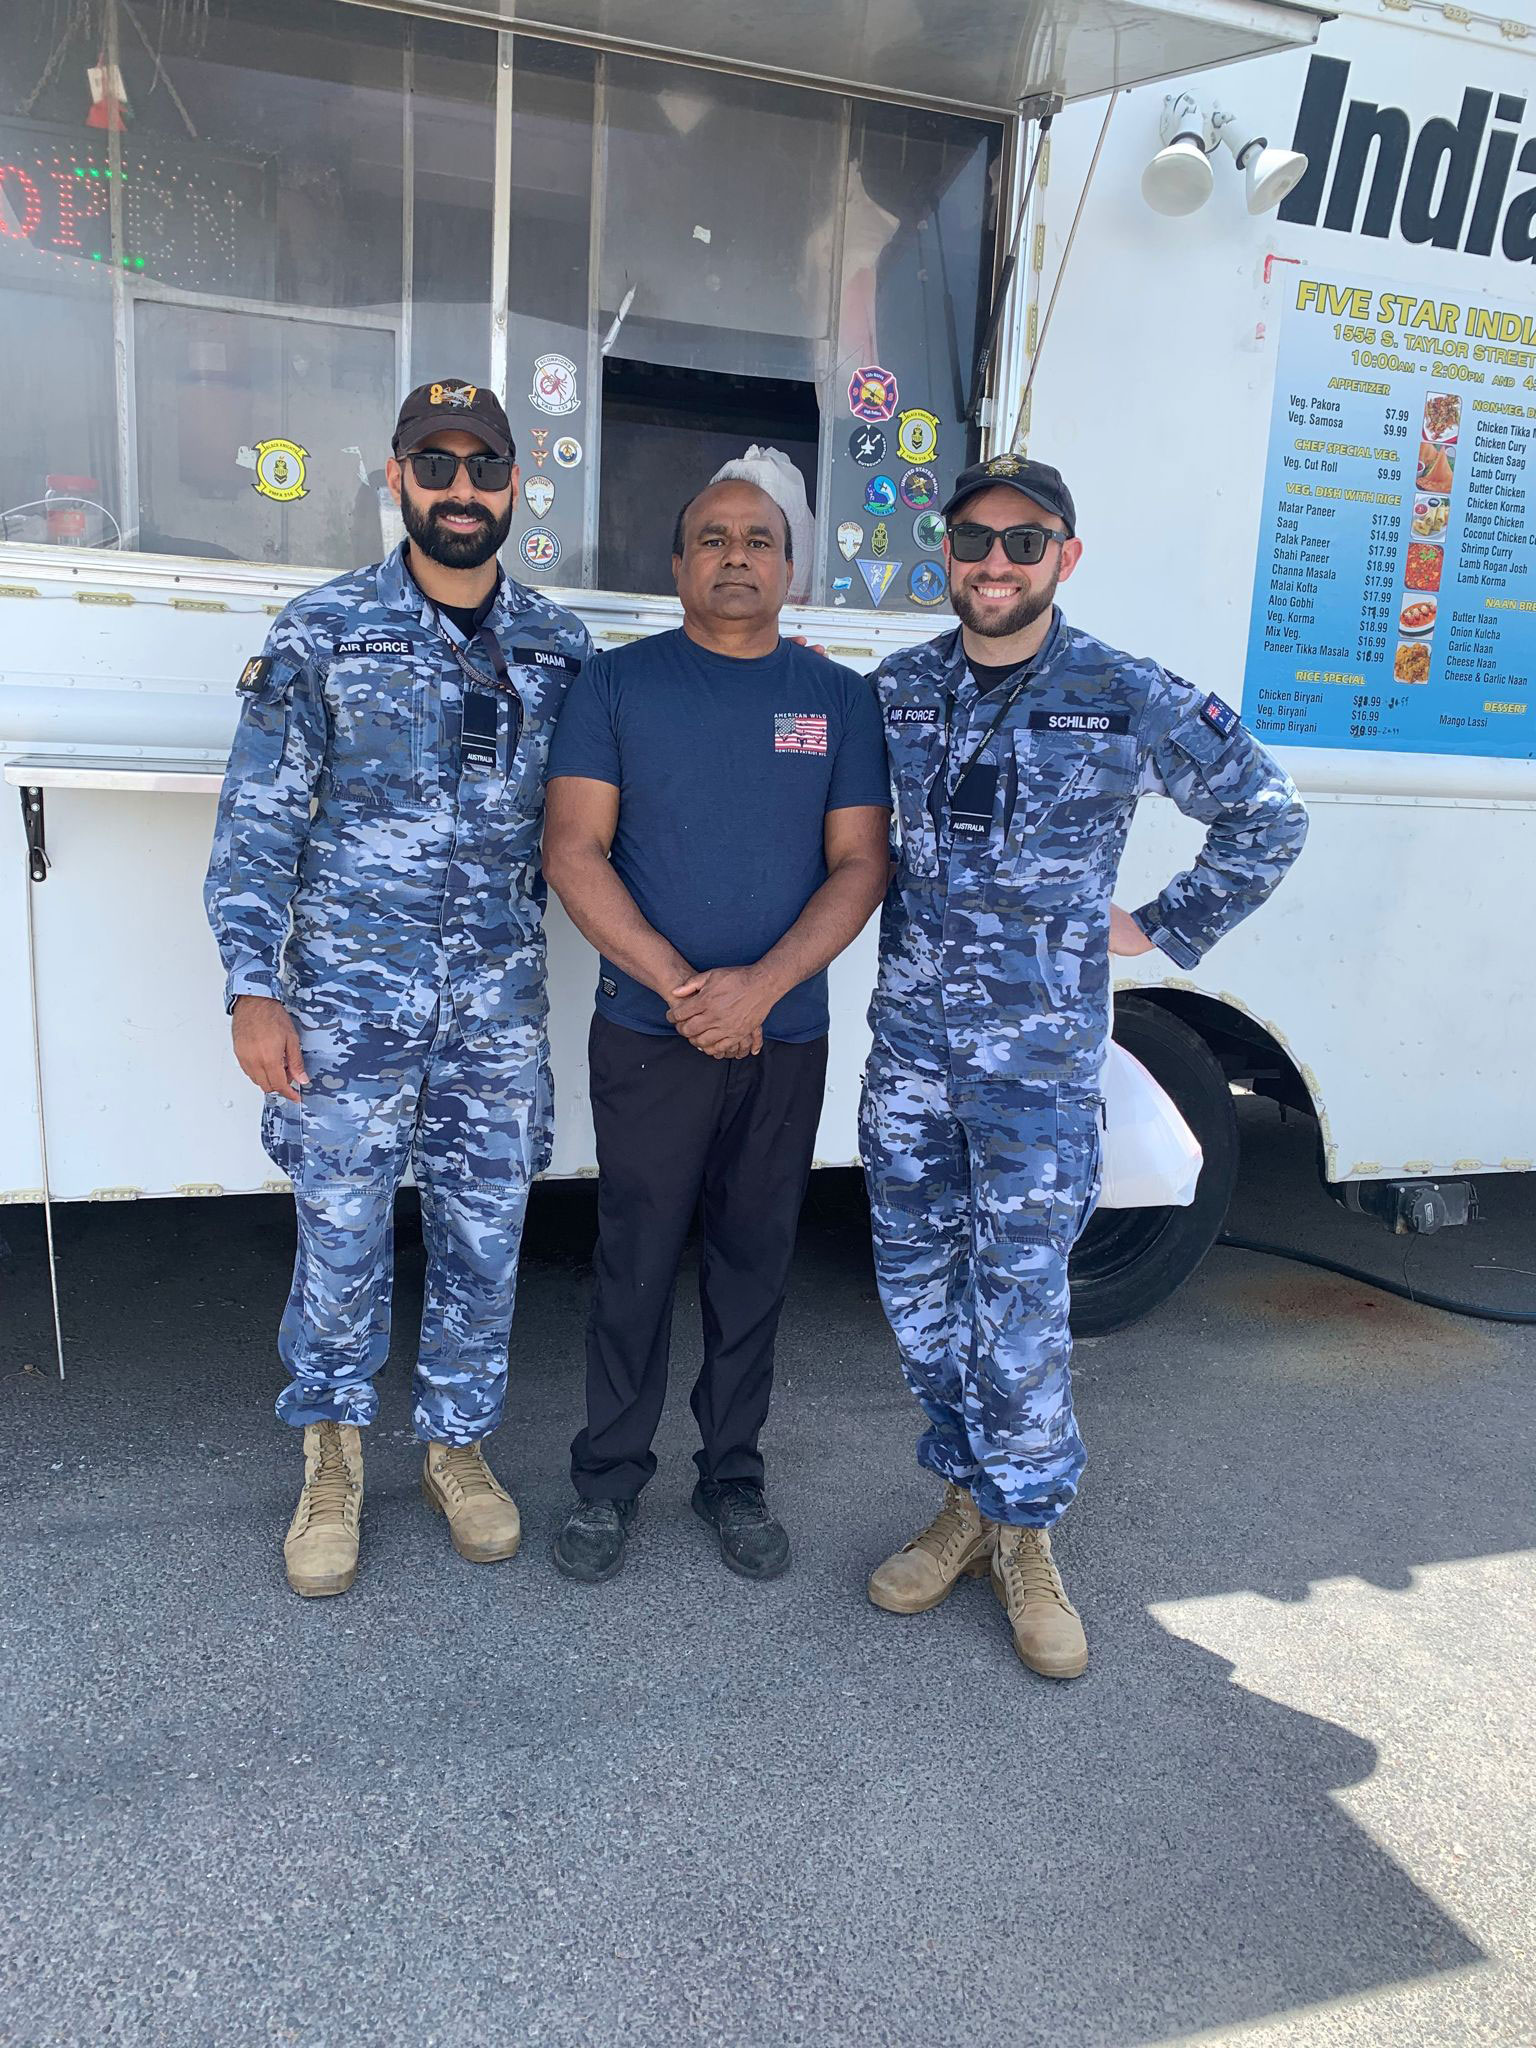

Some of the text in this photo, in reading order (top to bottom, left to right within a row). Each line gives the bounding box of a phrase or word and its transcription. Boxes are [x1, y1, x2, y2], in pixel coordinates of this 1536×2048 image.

[1296, 280, 1372, 320] FIVE
[1377, 294, 1460, 333] STAR
[1334, 325, 1375, 344] 1555
[1381, 331, 1398, 348] S.
[1404, 334, 1468, 359] TAYLOR
[540, 357, 571, 369] SCORPIONS
[1351, 350, 1415, 373] 10:00AM
[1432, 361, 1484, 383] 2:00PM
[1492, 375, 1515, 387] AND
[852, 387, 859, 396] 9
[1328, 377, 1391, 395] APPETIZER
[1290, 395, 1409, 421] Veg. Pakora $7.99
[1288, 411, 1407, 438] Veg. Samosa $9.99
[1477, 421, 1530, 437] Chicken Tikka
[1295, 439, 1400, 462] CHEF SPECIAL VEG.
[1475, 436, 1526, 454] Chicken Cury
[1284, 457, 1401, 481] Veg. Cut Roll $9.99
[1473, 452, 1526, 470] Chicken Saag
[901, 468, 915, 487] UNITED
[915, 466, 934, 478] STATES
[1471, 467, 1516, 484] Lamb Curry
[1286, 483, 1402, 506] VEG. DISH WITH RICE
[1469, 482, 1525, 498] Butter Chicken
[1468, 497, 1525, 513] Chicken Korma
[1279, 502, 1401, 527] Matar Paneer $17.99
[1466, 513, 1524, 528] Mango Chicken
[1277, 518, 1399, 542] Saag $14.99
[1464, 528, 1495, 540] Coconut
[1497, 531, 1527, 543] Chicken
[1275, 533, 1397, 557] Palak Paneer $17.99
[1461, 543, 1512, 559] Shrimp Curry
[1274, 548, 1395, 573] Shahi Paneer $18.99
[1460, 558, 1527, 574] Lamb Rogan Josh
[1272, 564, 1393, 588] Channa Masala $17.99
[1458, 573, 1506, 586] Lamb Korma
[1270, 579, 1391, 603] Malai Kofta $17.99
[1268, 595, 1287, 607] Aloo
[1290, 596, 1314, 609] Gobhi
[1485, 598, 1517, 609] NAAN
[1267, 610, 1388, 633] Veg. Korma $18.99
[1453, 612, 1497, 624] Butter Naan
[1265, 626, 1386, 648] Mix Veg. $16.99
[1451, 626, 1500, 639] Onion Kulcha
[339, 641, 409, 653] AIR FORCE
[1264, 641, 1294, 654] Paneer
[1296, 644, 1317, 655] Tikka
[1319, 645, 1349, 657] Masala
[1449, 641, 1493, 654] Garlic Naan
[535, 652, 565, 668] DHAMI
[1447, 656, 1496, 669] Cheese Naan
[1296, 671, 1366, 685] RICE SPECIAL
[1445, 670, 1527, 686] Cheese & Garlic Naan
[1259, 689, 1293, 702] Chicken
[1295, 691, 1323, 704] Biryani
[890, 709, 935, 720] AIR FORCE
[1257, 705, 1379, 721] Veg. Biryani $16.99
[1484, 702, 1528, 714] DESSERT
[1049, 715, 1110, 730] SCHILIRO
[1256, 720, 1286, 733] Shrimp
[1288, 722, 1317, 733] Biryani
[1440, 715, 1488, 728] Mango Lassi
[467, 753, 493, 763] AUSTRALIA
[953, 822, 985, 833] AUSTRALIA
